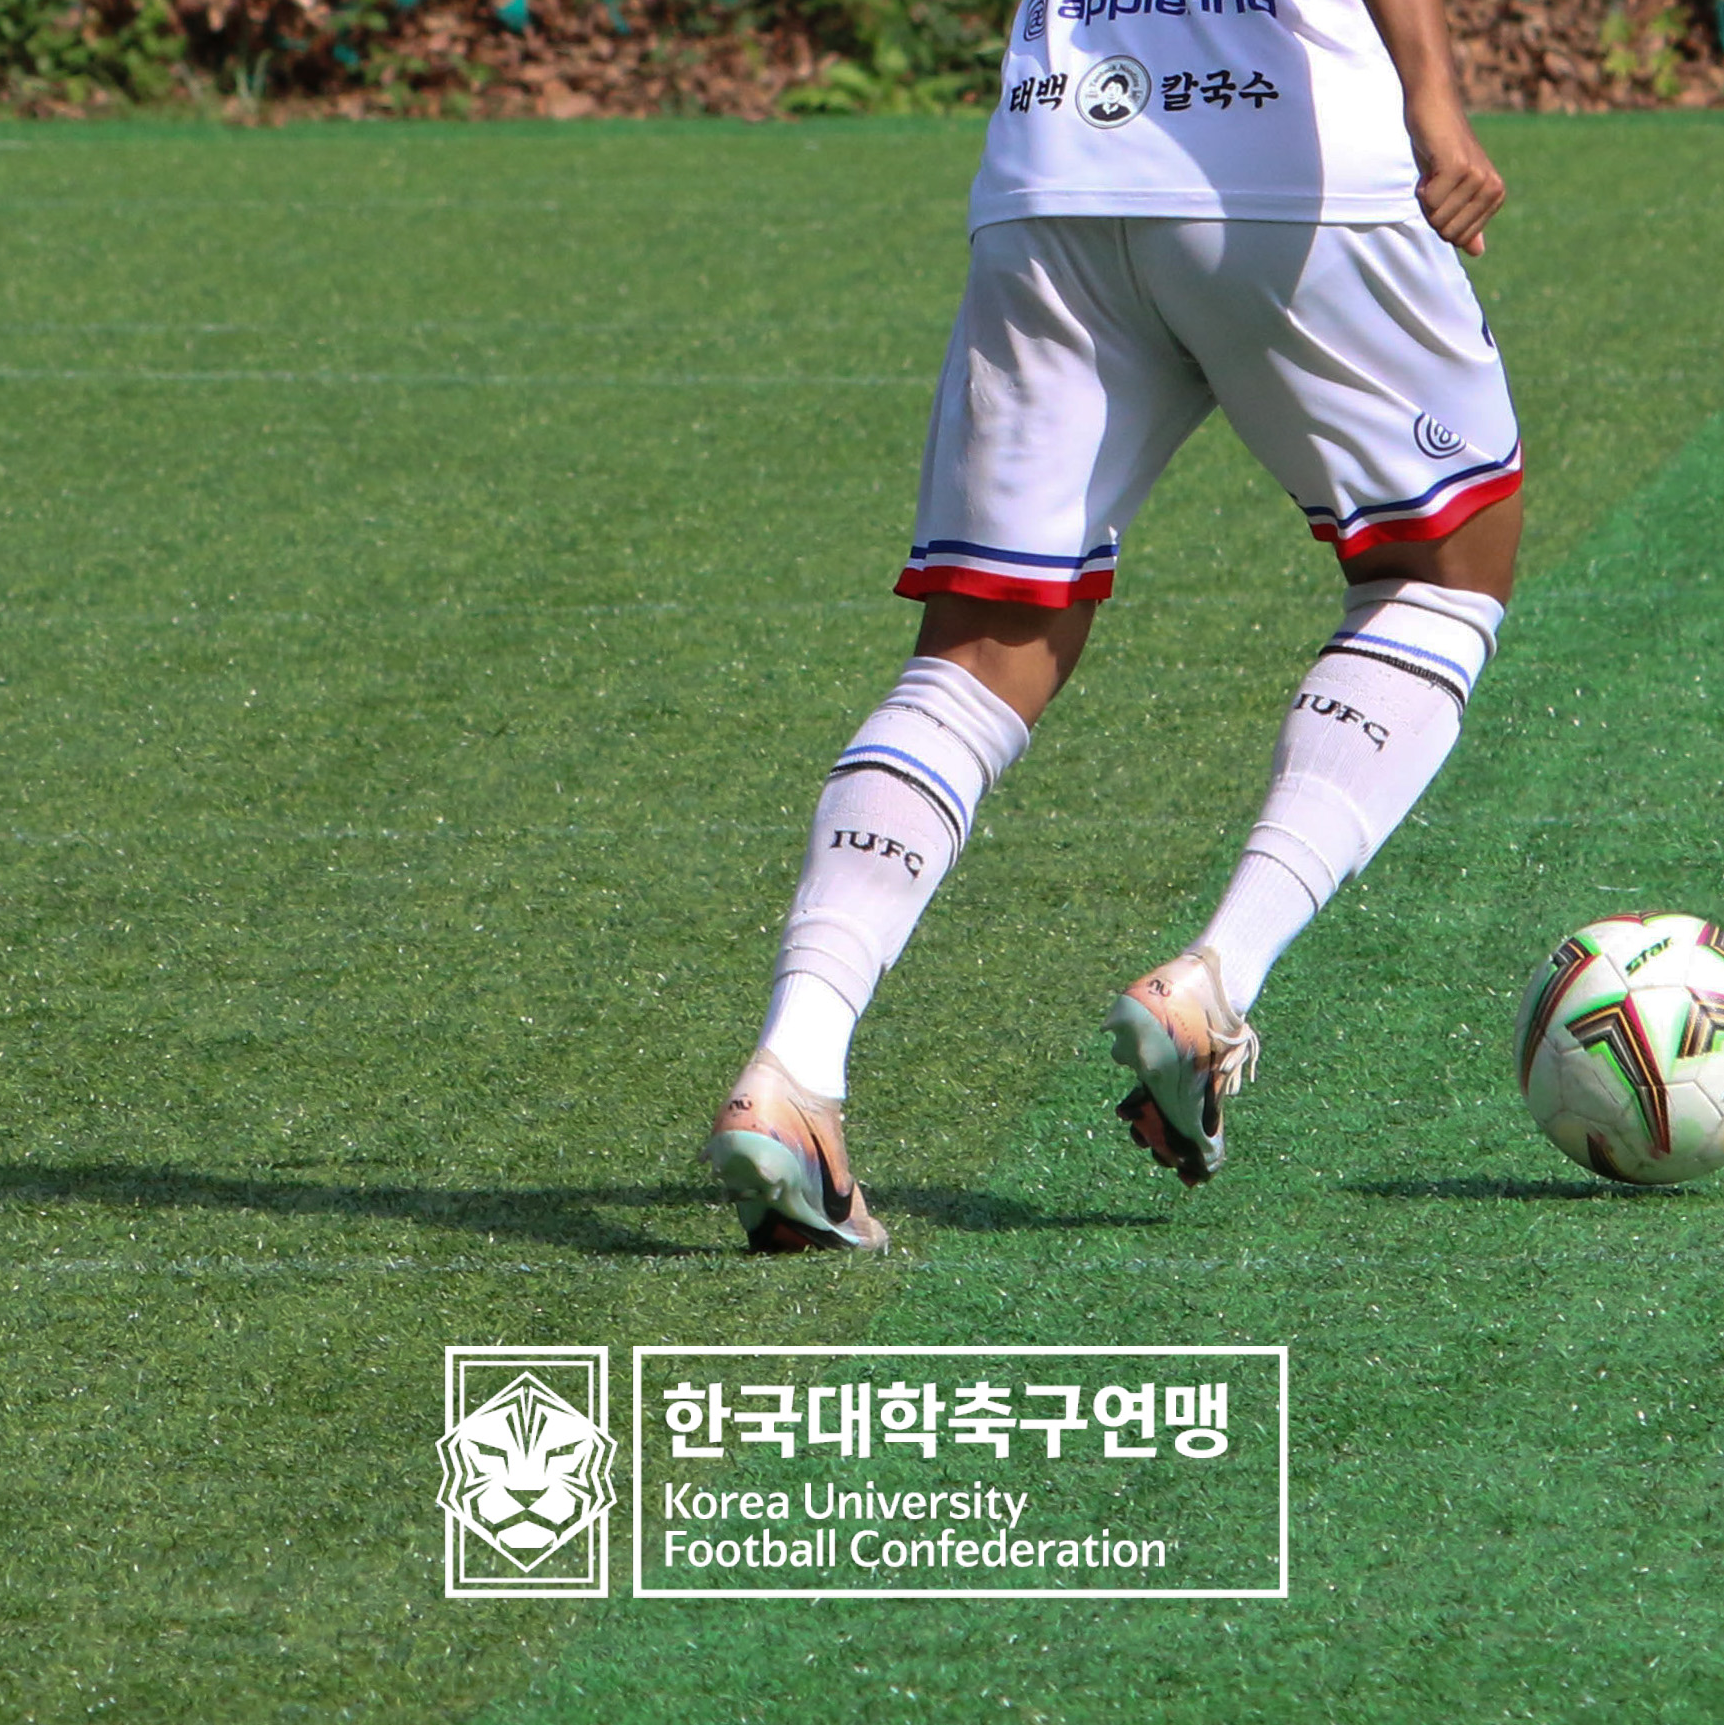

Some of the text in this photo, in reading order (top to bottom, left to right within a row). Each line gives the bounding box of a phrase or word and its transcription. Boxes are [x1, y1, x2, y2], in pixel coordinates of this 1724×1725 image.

[1010, 73, 1068, 113] 태백
[1161, 70, 1279, 112] 칼국수
[1294, 693, 1390, 752] IUFC
[830, 829, 925, 879] IUFC
